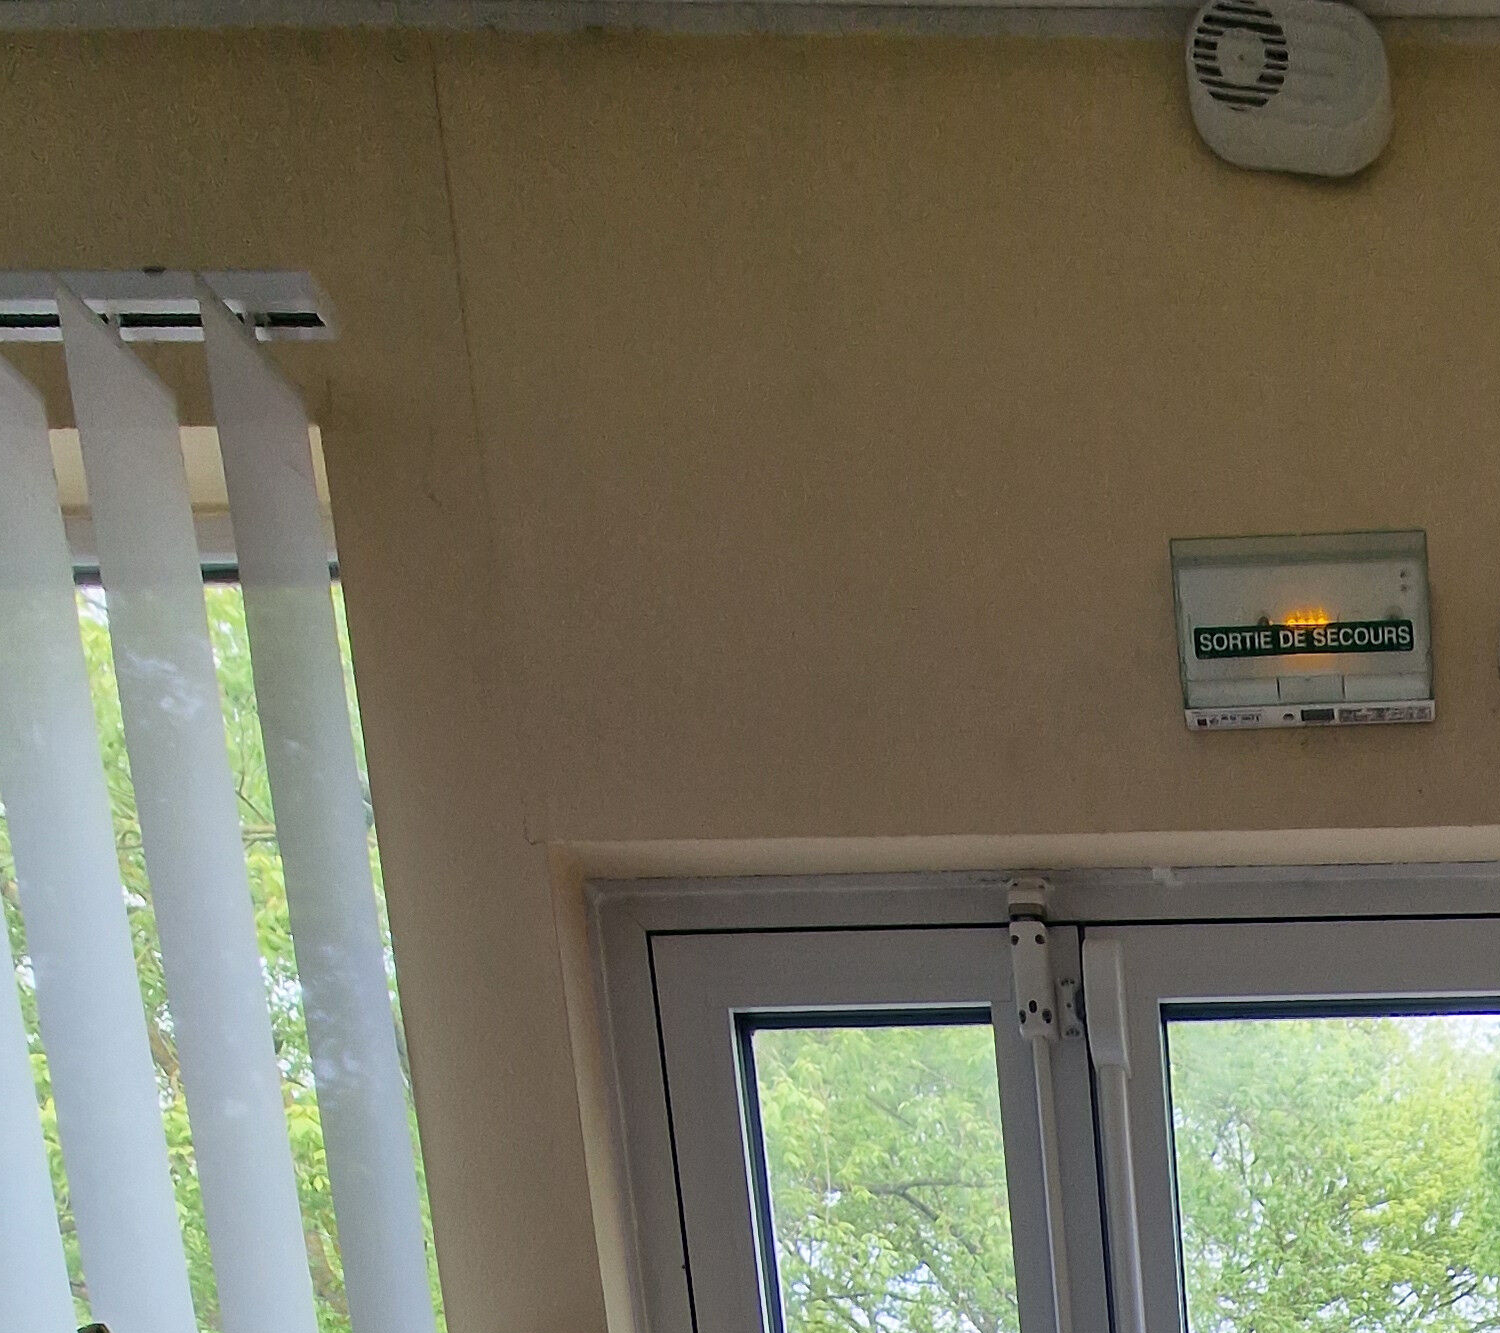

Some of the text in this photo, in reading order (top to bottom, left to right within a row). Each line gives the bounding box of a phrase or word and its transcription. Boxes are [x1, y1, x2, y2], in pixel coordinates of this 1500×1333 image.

[1199, 625, 1411, 653] SORTIE DE SECOURS
